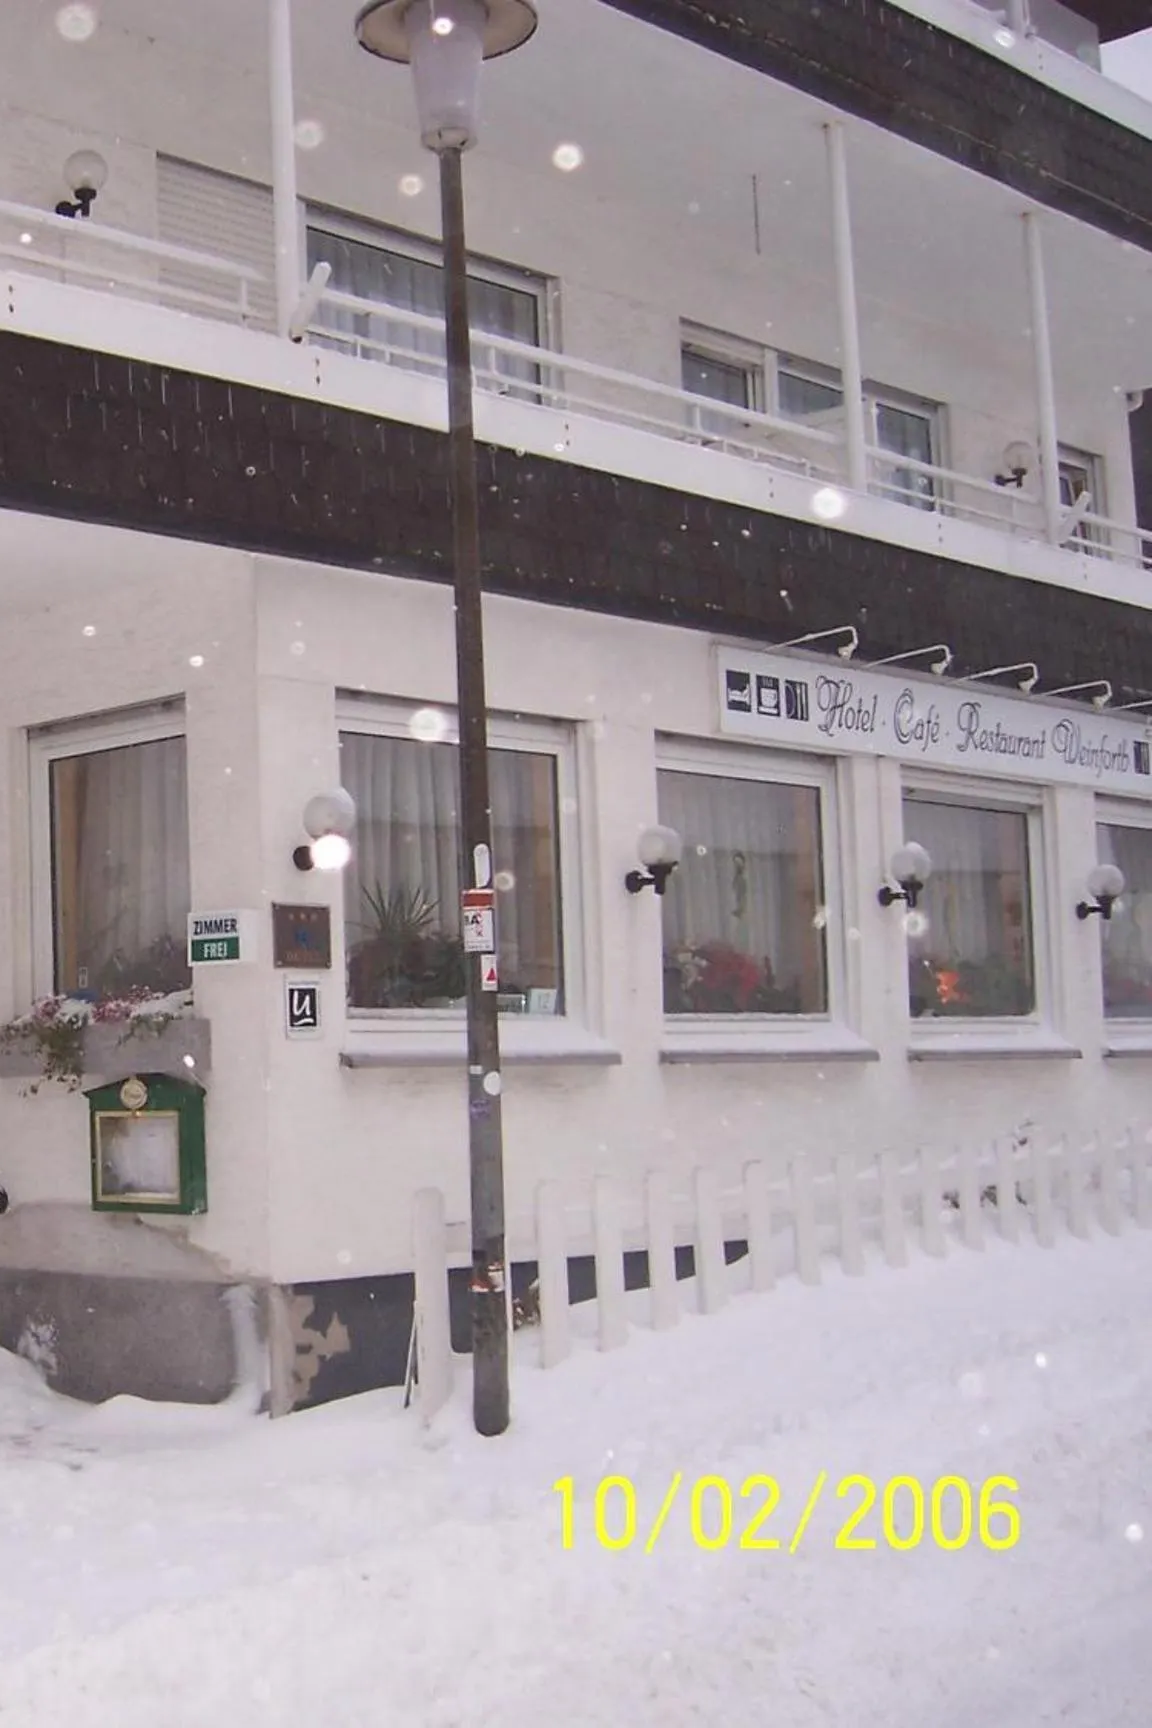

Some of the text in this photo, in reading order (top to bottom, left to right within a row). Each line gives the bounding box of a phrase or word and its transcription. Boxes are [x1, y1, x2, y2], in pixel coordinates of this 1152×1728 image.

[815, 675, 878, 736] Hotel
[894, 688, 941, 752] Café
[956, 702, 1047, 759] Restaurant
[193, 918, 238, 936] ZIMMER
[203, 941, 228, 959] FREI
